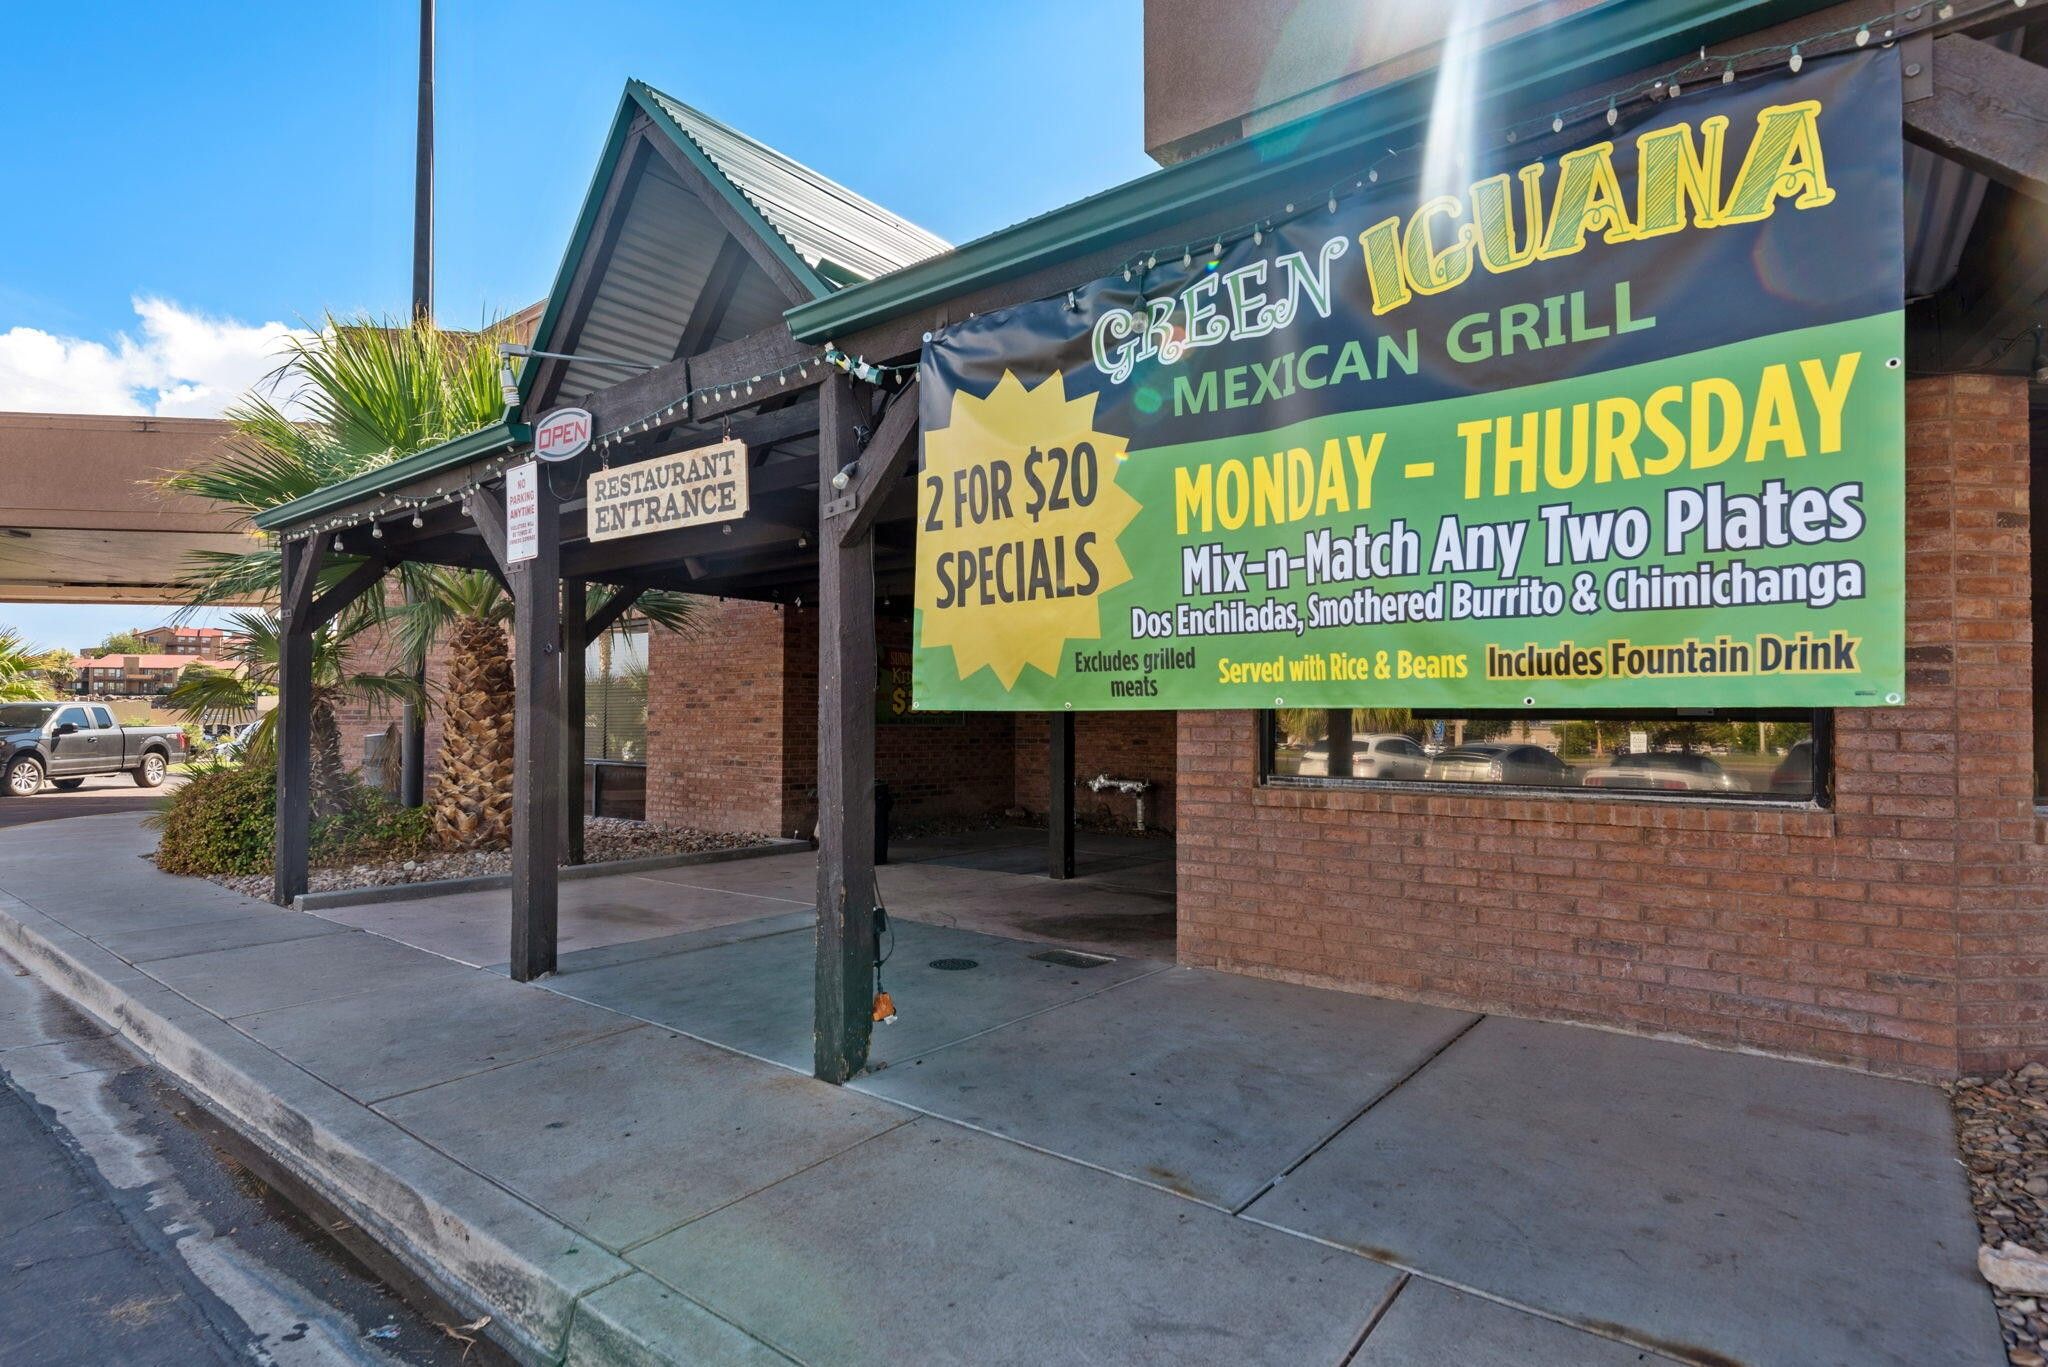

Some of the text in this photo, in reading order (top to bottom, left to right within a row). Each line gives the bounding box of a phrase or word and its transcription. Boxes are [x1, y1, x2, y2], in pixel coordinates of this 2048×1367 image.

[1092, 100, 1836, 384] GREEN IGUANA
[1173, 281, 1656, 416] MEXICAN GRILL
[538, 419, 588, 449] OPEN
[1174, 432, 1387, 535] MONDAY
[1457, 351, 1862, 499] THURSDAY
[510, 490, 534, 505] PARKING
[517, 479, 526, 489] NO
[594, 450, 735, 502] RESTAURANT
[925, 441, 1098, 531] 2 FOR $20
[510, 504, 535, 519] ANYTIME
[595, 481, 737, 533] ENTRANCE
[1182, 478, 1866, 596] Mix-n-Match Any Two Plates
[935, 532, 1100, 609] SPECIALS
[1131, 559, 1866, 639] Dos Enchiladas, Smothered Burrito & Chimichanga
[1075, 647, 1195, 674] Excludes grilled
[1218, 650, 1467, 684] Served with Rice & Beans
[1487, 633, 1856, 677] Includes Fountain Drink
[1110, 676, 1158, 698] meats
